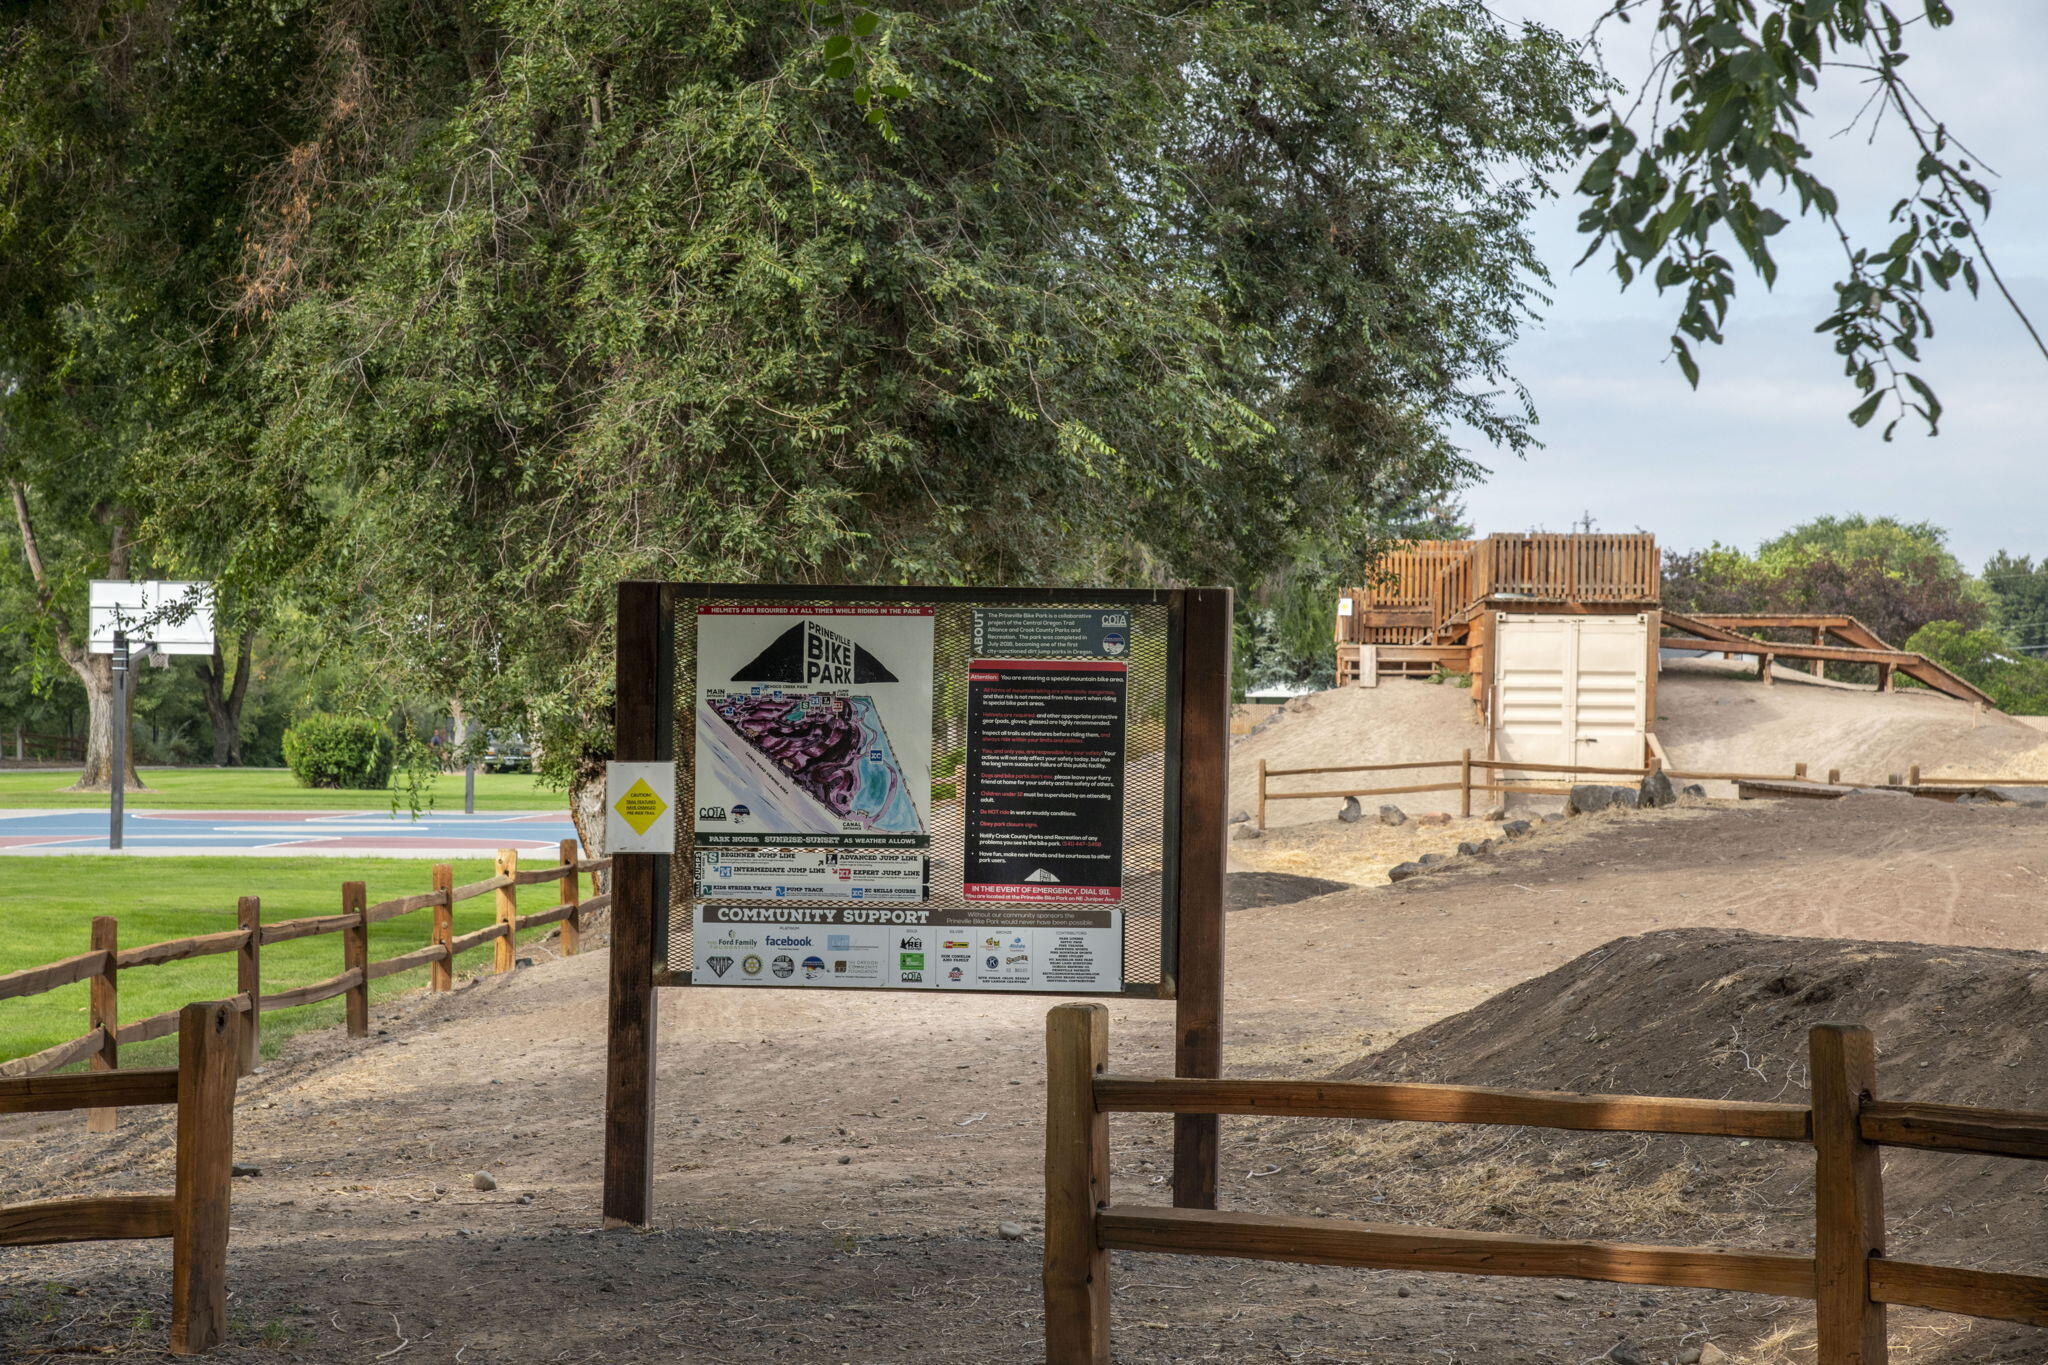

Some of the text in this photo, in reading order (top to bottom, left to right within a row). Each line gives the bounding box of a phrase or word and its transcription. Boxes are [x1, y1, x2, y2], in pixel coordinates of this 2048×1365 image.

[808, 620, 851, 646] PRINEVILLE
[972, 610, 983, 654] ABOUT
[808, 632, 852, 667] BIKE
[807, 660, 852, 684] PARK
[700, 807, 726, 818] COTA
[718, 908, 930, 923] COMMUNITY SUPPORT
[766, 936, 812, 946] facebook
